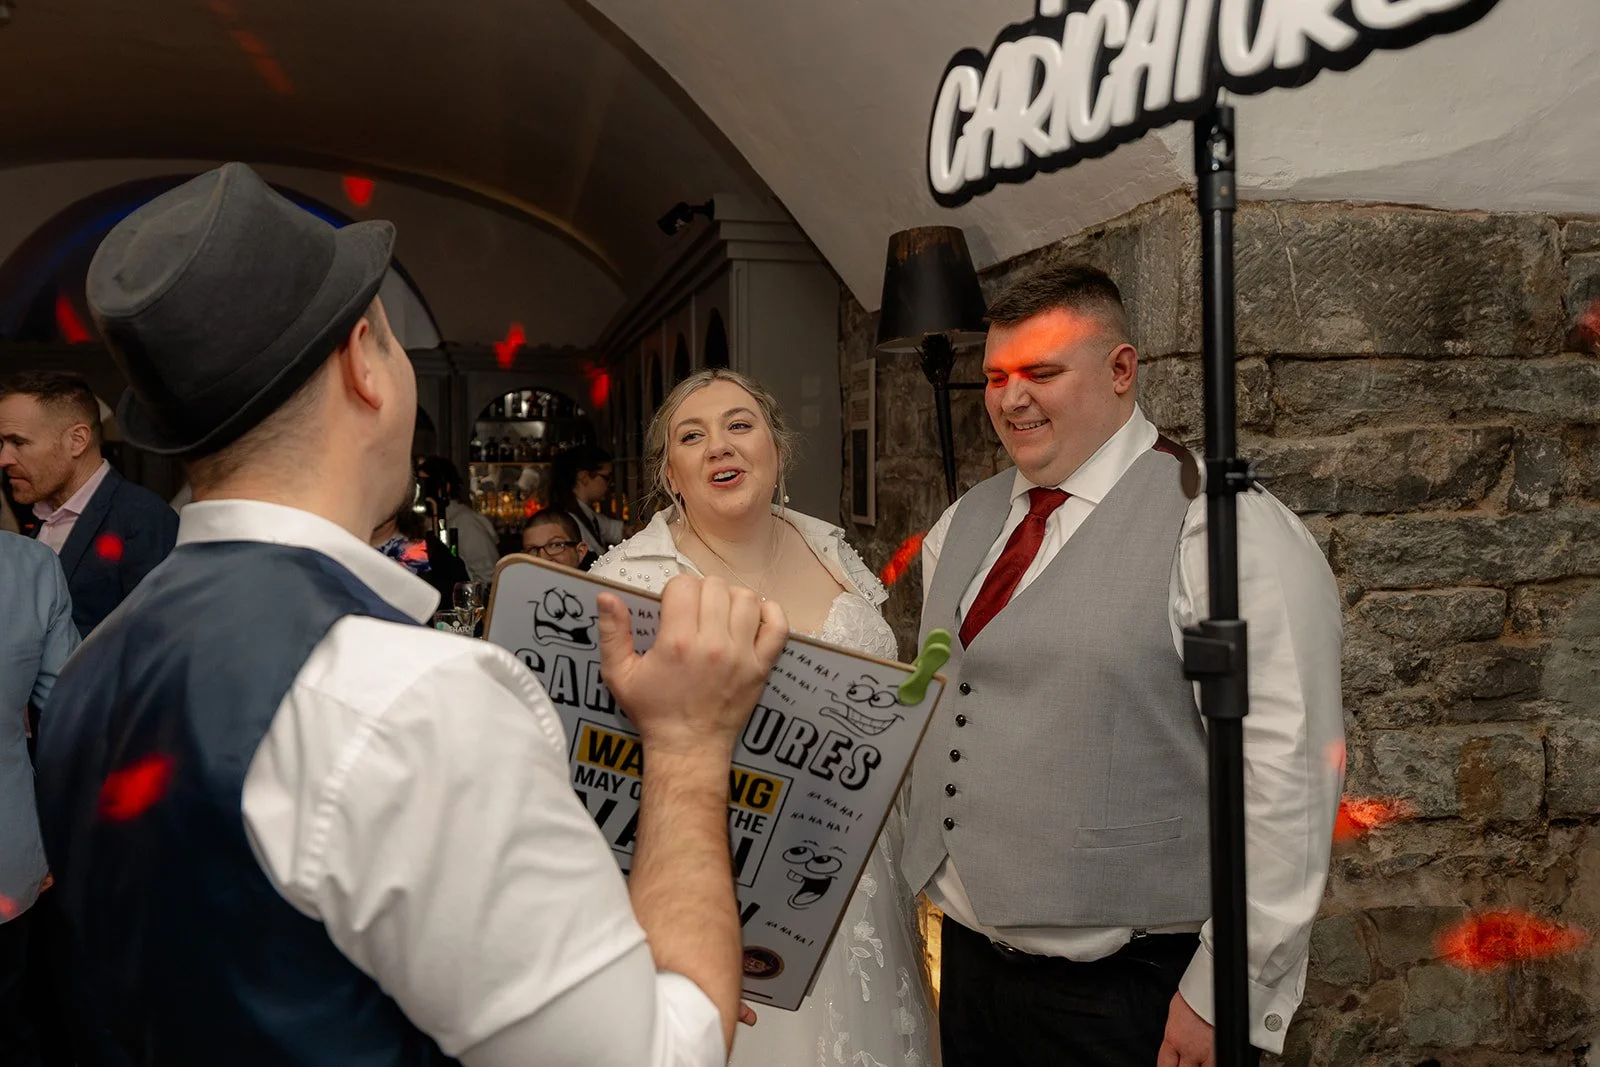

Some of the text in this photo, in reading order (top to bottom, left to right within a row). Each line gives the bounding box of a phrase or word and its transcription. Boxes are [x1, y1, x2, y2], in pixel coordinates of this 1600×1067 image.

[929, 0, 1476, 194] CARICATUR
[574, 765, 625, 794] MAY
[589, 731, 774, 808] WANG
